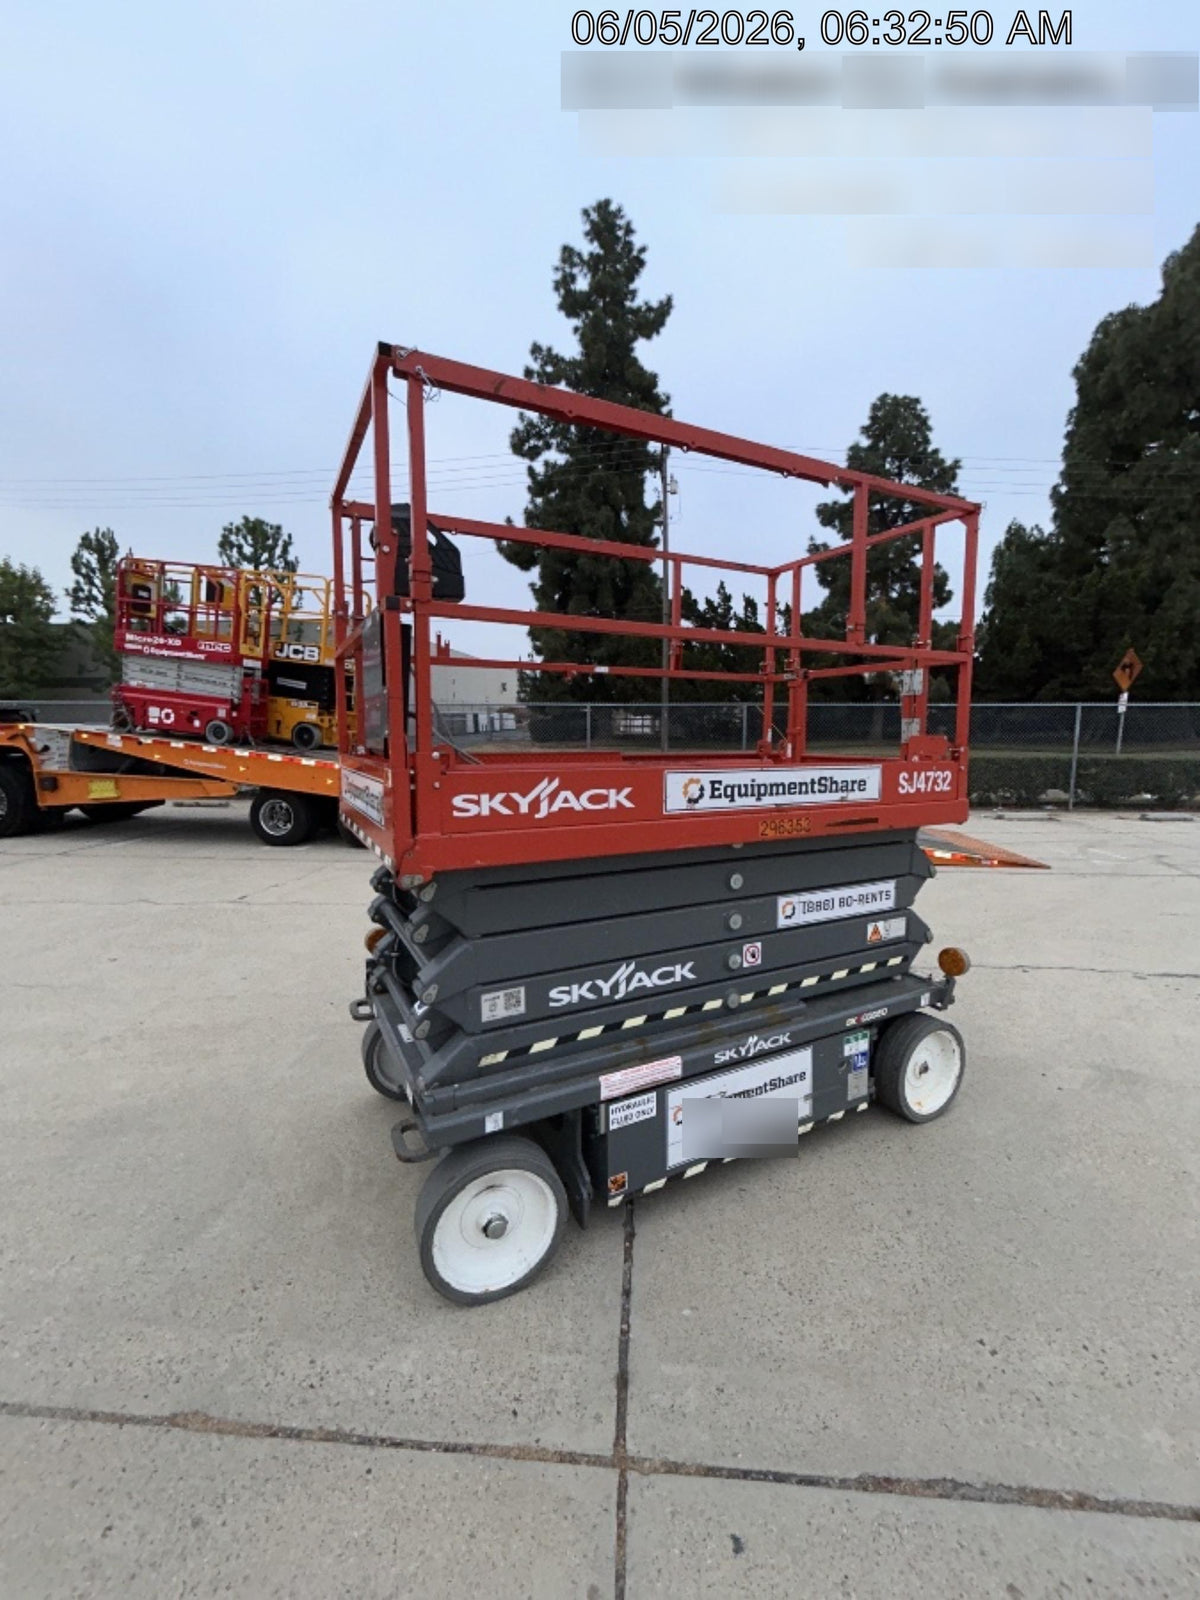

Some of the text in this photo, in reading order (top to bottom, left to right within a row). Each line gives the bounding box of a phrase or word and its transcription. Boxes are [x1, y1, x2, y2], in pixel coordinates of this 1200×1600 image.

[274, 643, 320, 661] JCB
[709, 776, 867, 803] EquipmentShare
[898, 771, 953, 795] SJ4732
[452, 777, 636, 819] SKYJACK
[548, 961, 698, 1008] SKYJACK
[714, 1032, 792, 1064] SKYJACK
